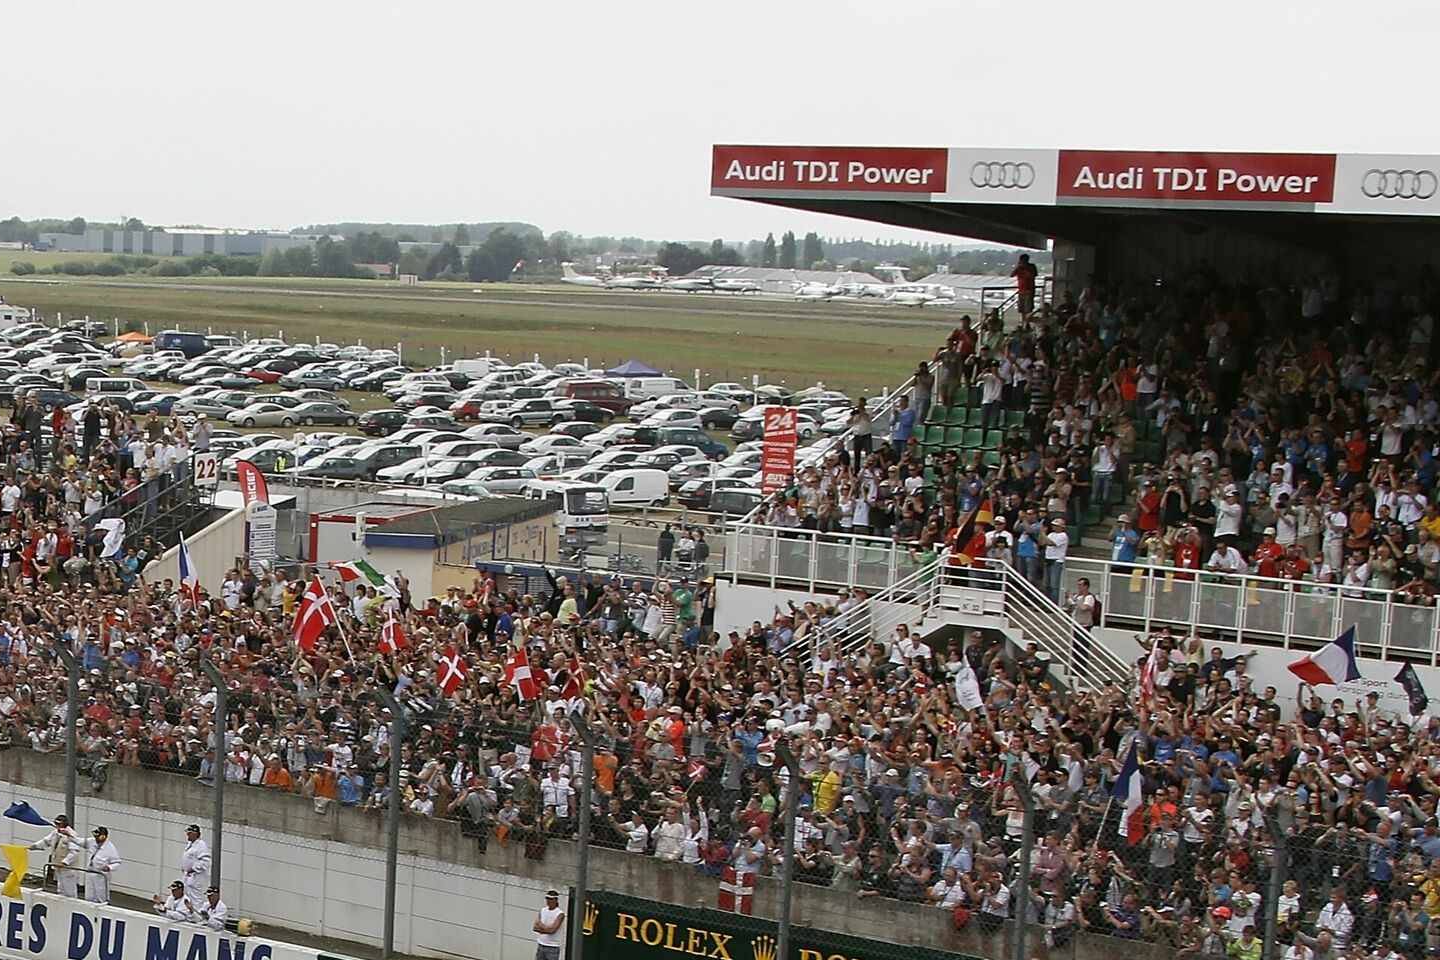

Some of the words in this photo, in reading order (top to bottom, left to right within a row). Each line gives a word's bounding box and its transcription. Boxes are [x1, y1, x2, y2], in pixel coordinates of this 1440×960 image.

[725, 159, 786, 183] Audi
[793, 161, 840, 184] TDI
[847, 162, 934, 186] Power
[1074, 165, 1146, 191] Audi
[1153, 167, 1208, 192] TDI
[1218, 169, 1319, 196] Power
[766, 412, 794, 430] 24
[197, 459, 216, 479] 22
